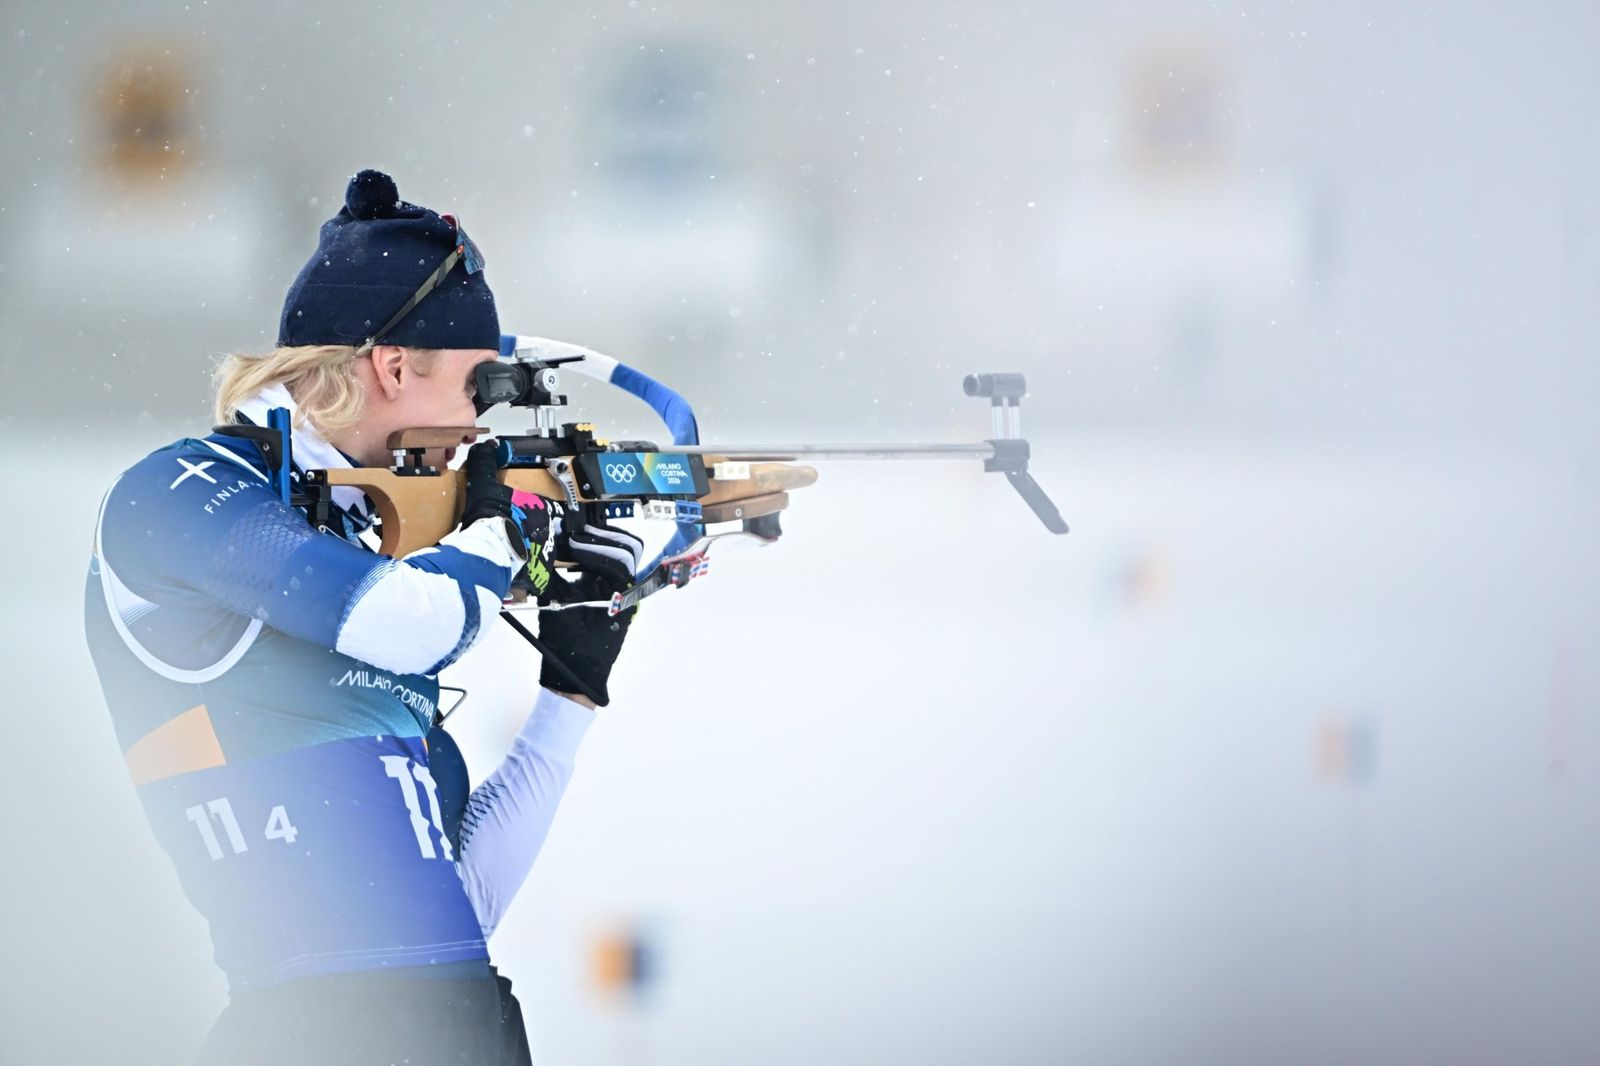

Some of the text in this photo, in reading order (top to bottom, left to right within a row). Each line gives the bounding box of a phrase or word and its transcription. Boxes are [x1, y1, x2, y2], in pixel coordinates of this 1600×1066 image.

[204, 480, 263, 514] FINLA
[184, 796, 298, 861] 11 4
